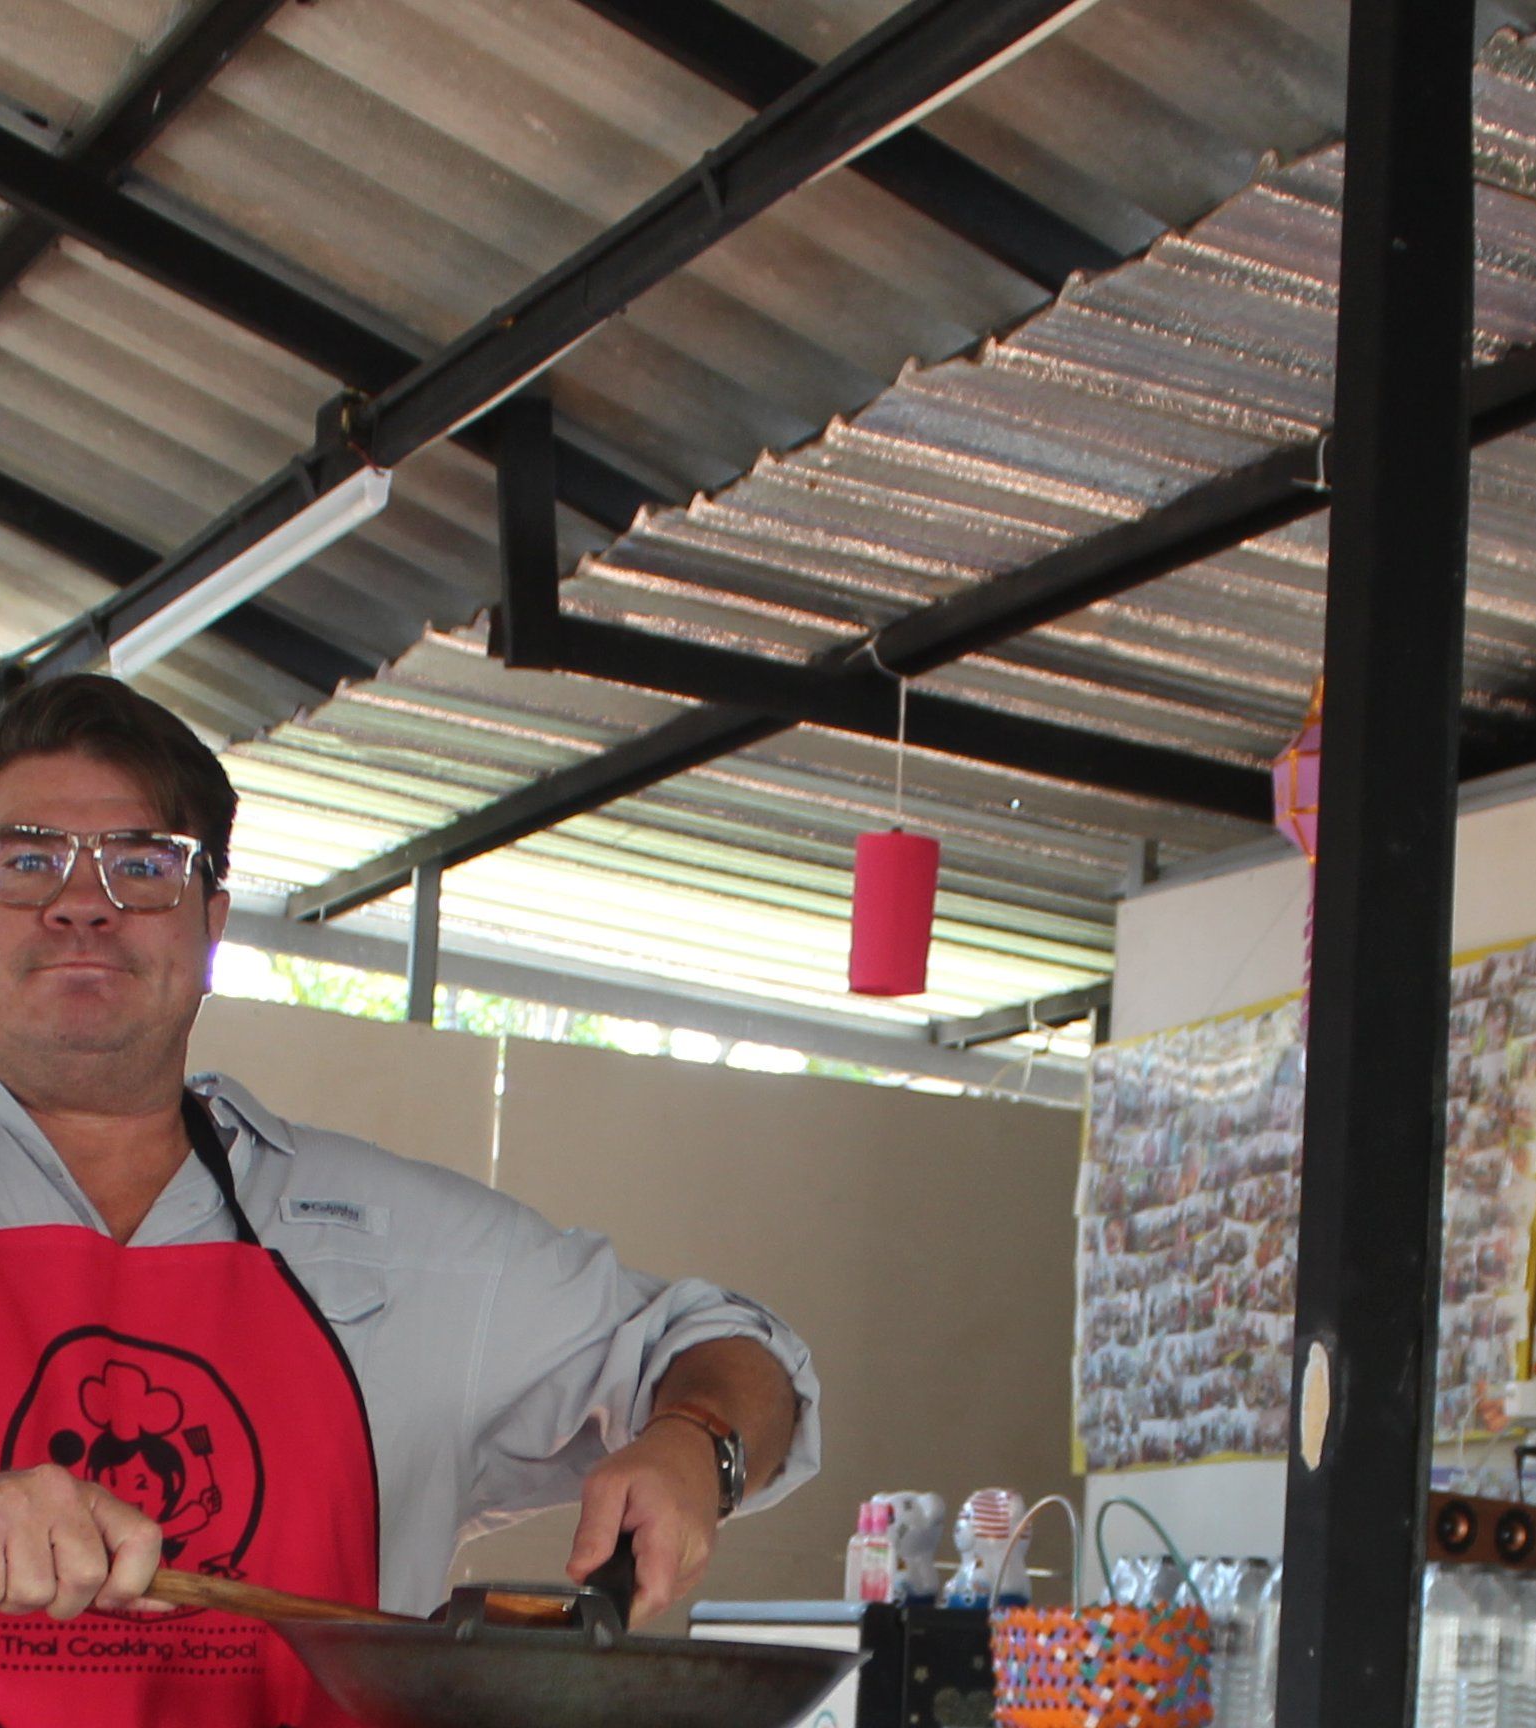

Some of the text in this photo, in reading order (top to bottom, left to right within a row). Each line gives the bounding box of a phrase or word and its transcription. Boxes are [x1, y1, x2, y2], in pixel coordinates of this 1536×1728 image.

[0, 1634, 257, 1662] Thai Cooking School
